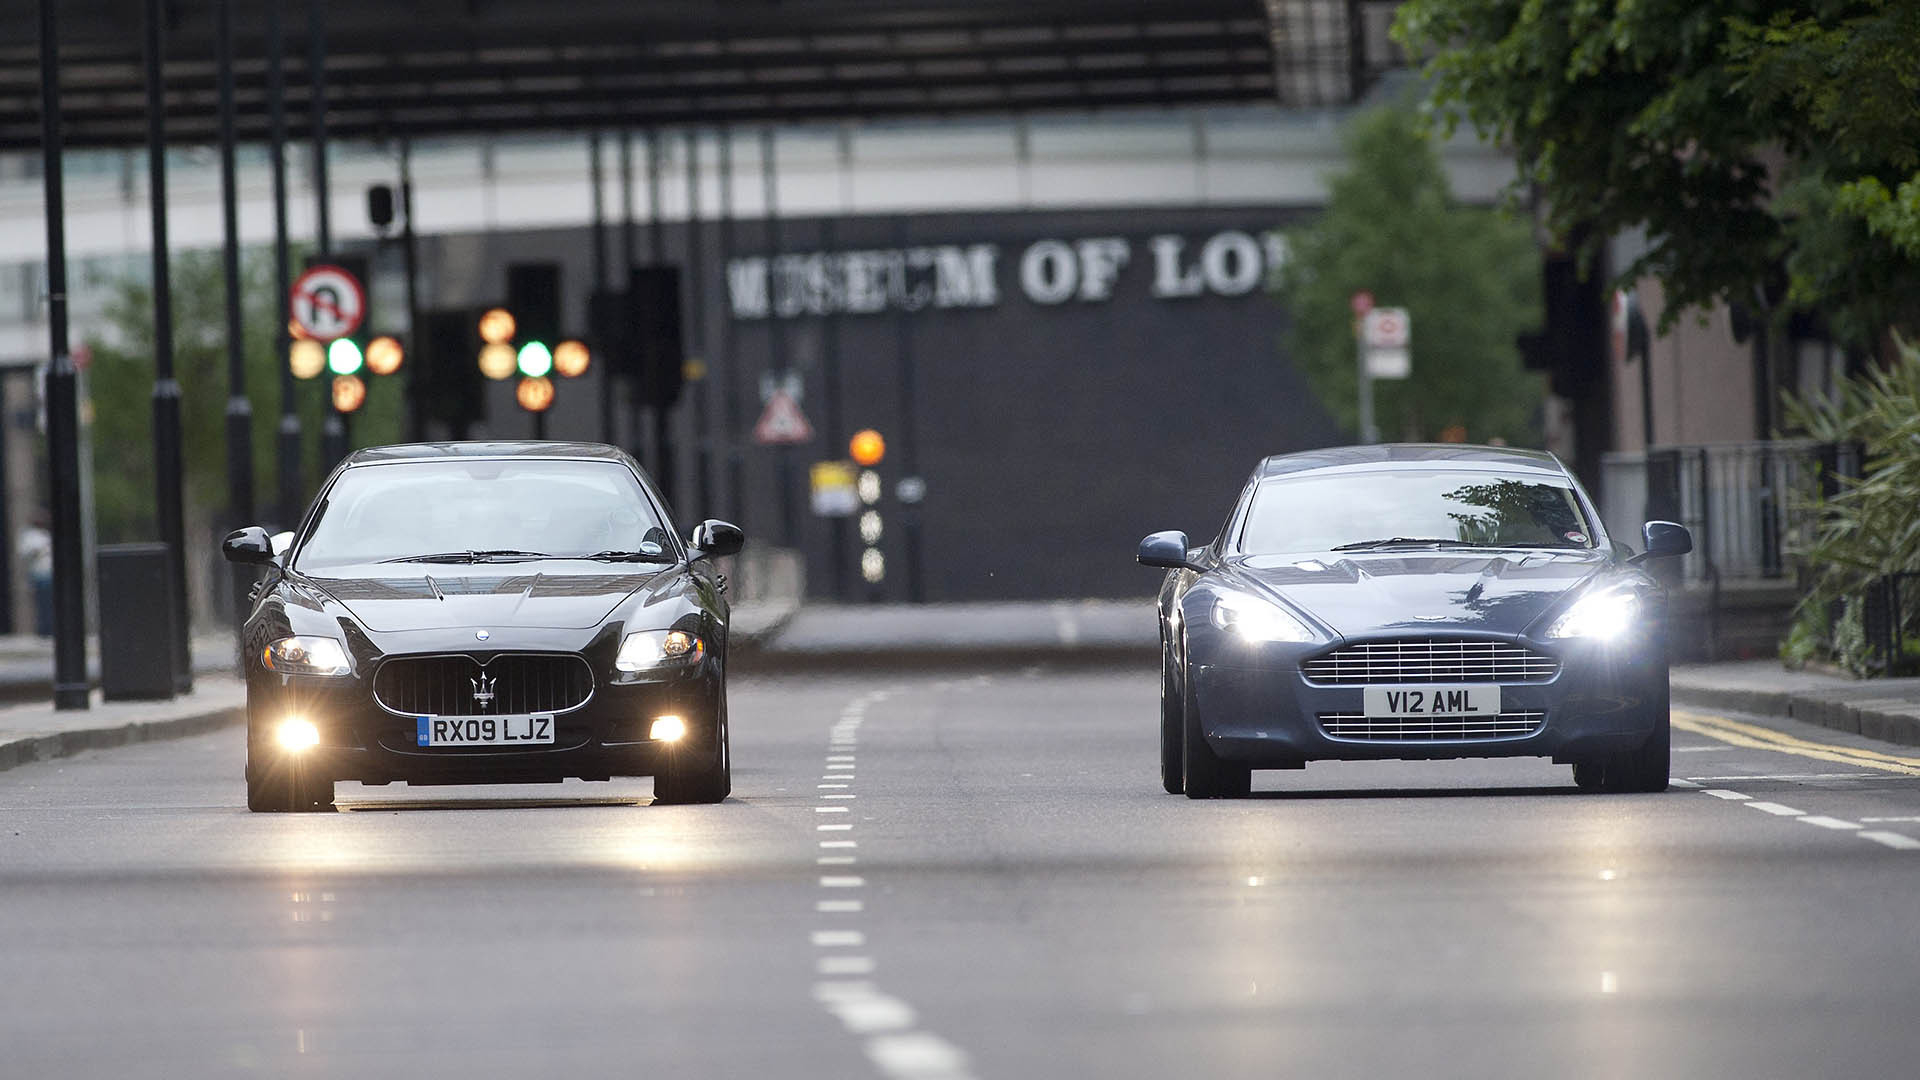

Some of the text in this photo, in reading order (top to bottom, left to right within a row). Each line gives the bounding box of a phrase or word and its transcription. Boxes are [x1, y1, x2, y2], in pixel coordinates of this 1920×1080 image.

[1020, 237, 1131, 304] OF
[1387, 690, 1478, 713] V12 AML
[433, 718, 550, 742] RX09 LJZ
